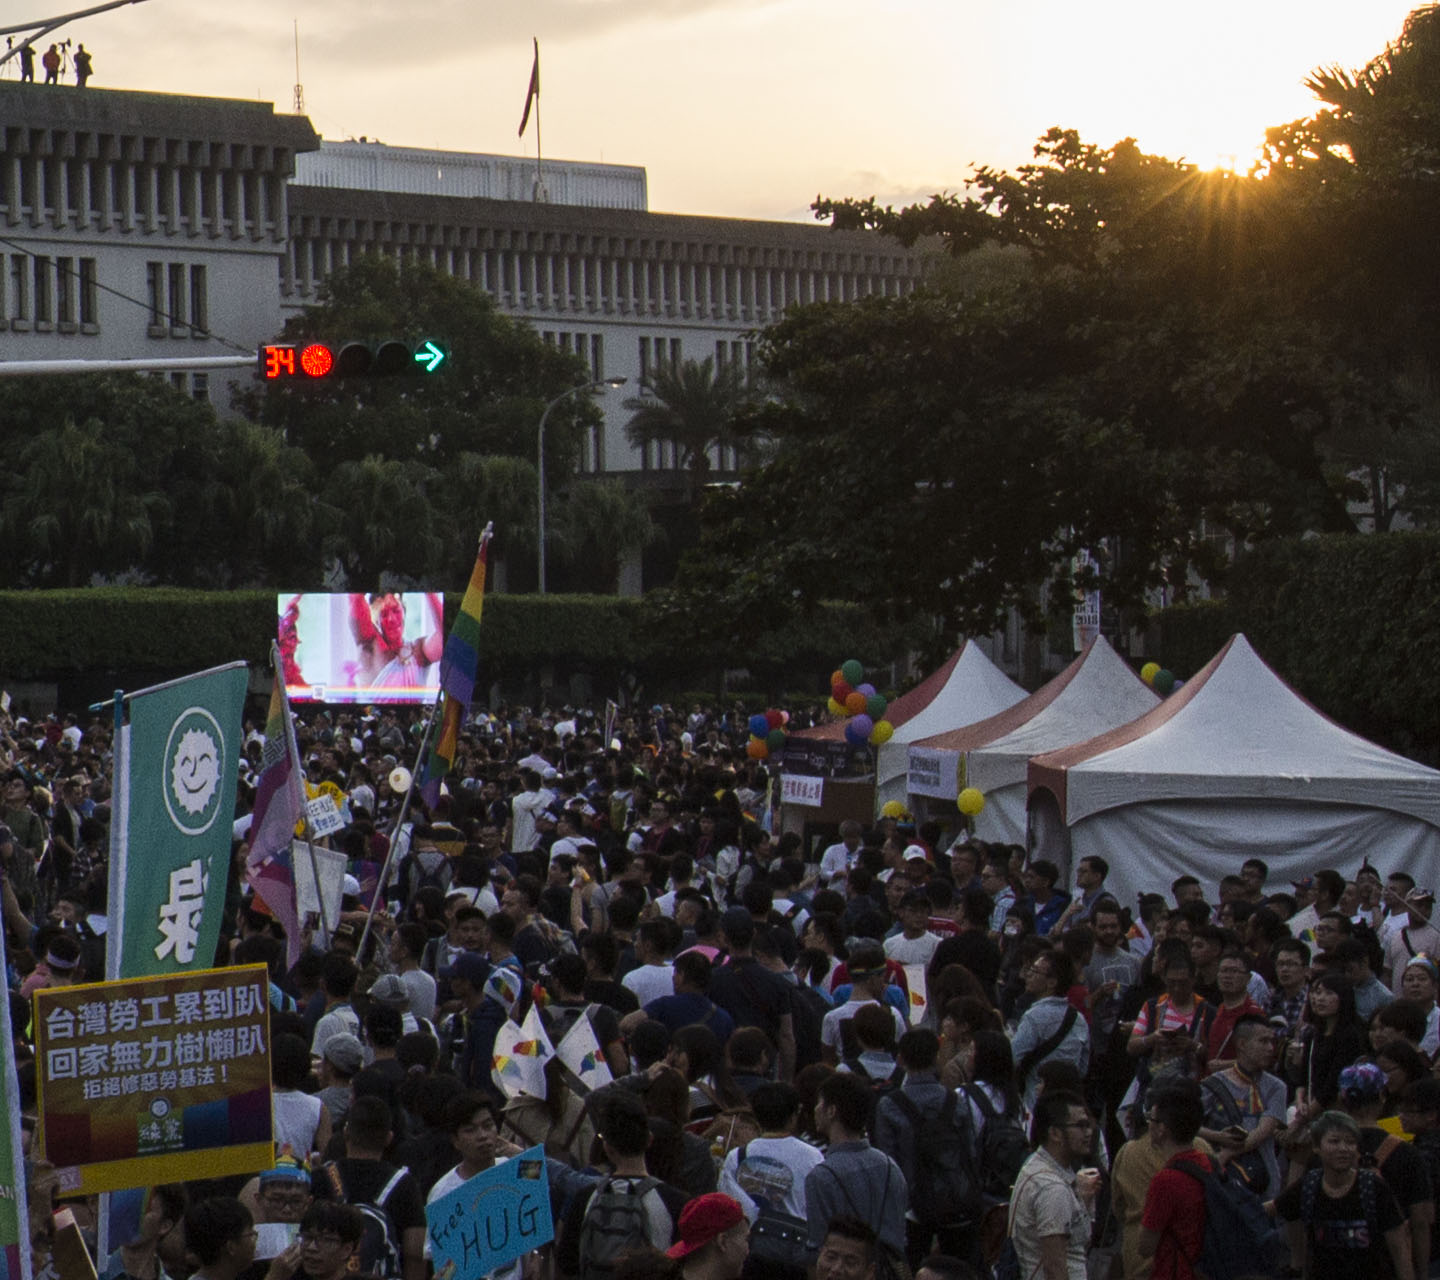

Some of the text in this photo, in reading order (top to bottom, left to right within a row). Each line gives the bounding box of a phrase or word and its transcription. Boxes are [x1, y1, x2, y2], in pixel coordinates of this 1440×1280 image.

[265, 346, 295, 378] 34
[46, 983, 265, 1040] 台灣勞工累到趴
[47, 1024, 266, 1081] 回家無力樹懶趴
[430, 1202, 464, 1250] Free
[461, 1194, 539, 1271] HUG
